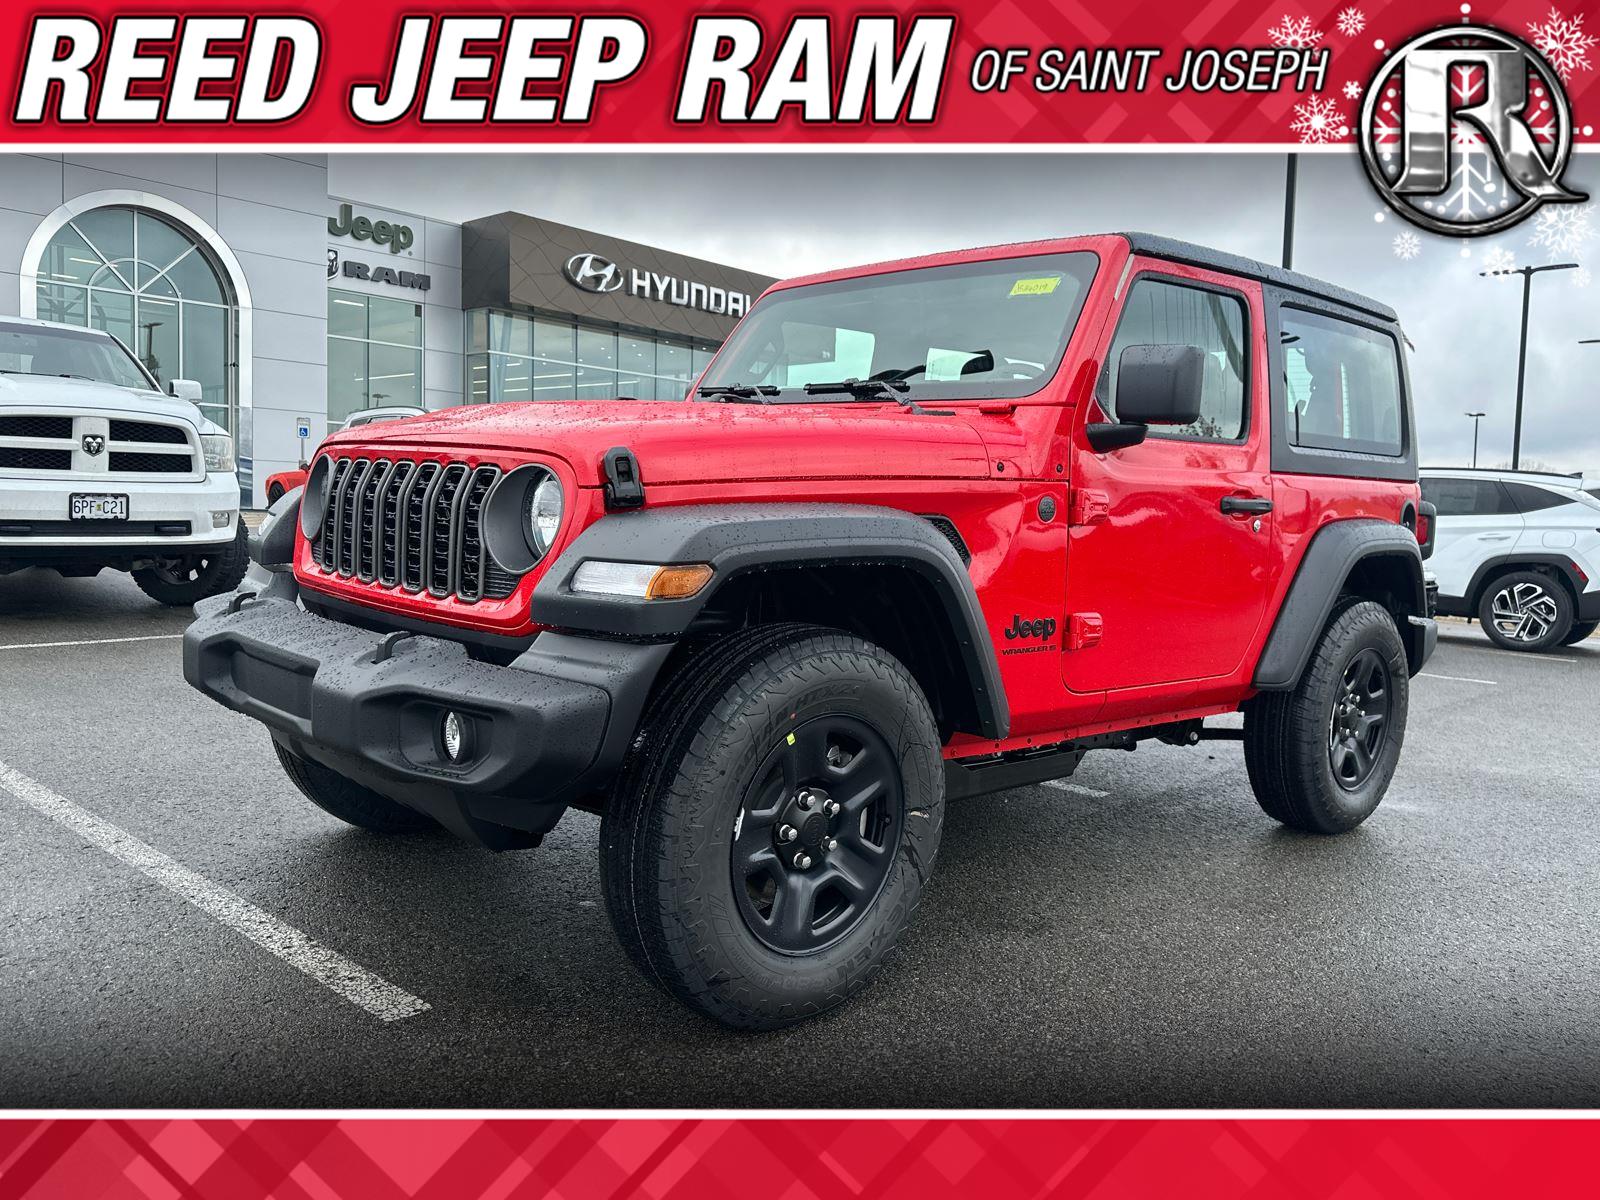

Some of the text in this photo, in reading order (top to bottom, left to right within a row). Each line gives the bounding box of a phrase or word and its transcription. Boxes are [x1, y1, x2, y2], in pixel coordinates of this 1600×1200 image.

[327, 203, 414, 254] Jeep
[342, 261, 431, 291] RAM
[630, 268, 751, 318] HYUNDAI
[73, 500, 124, 514] 6PF C21
[1004, 614, 1057, 641] Jeep
[1001, 645, 1048, 656] WRANGLER
